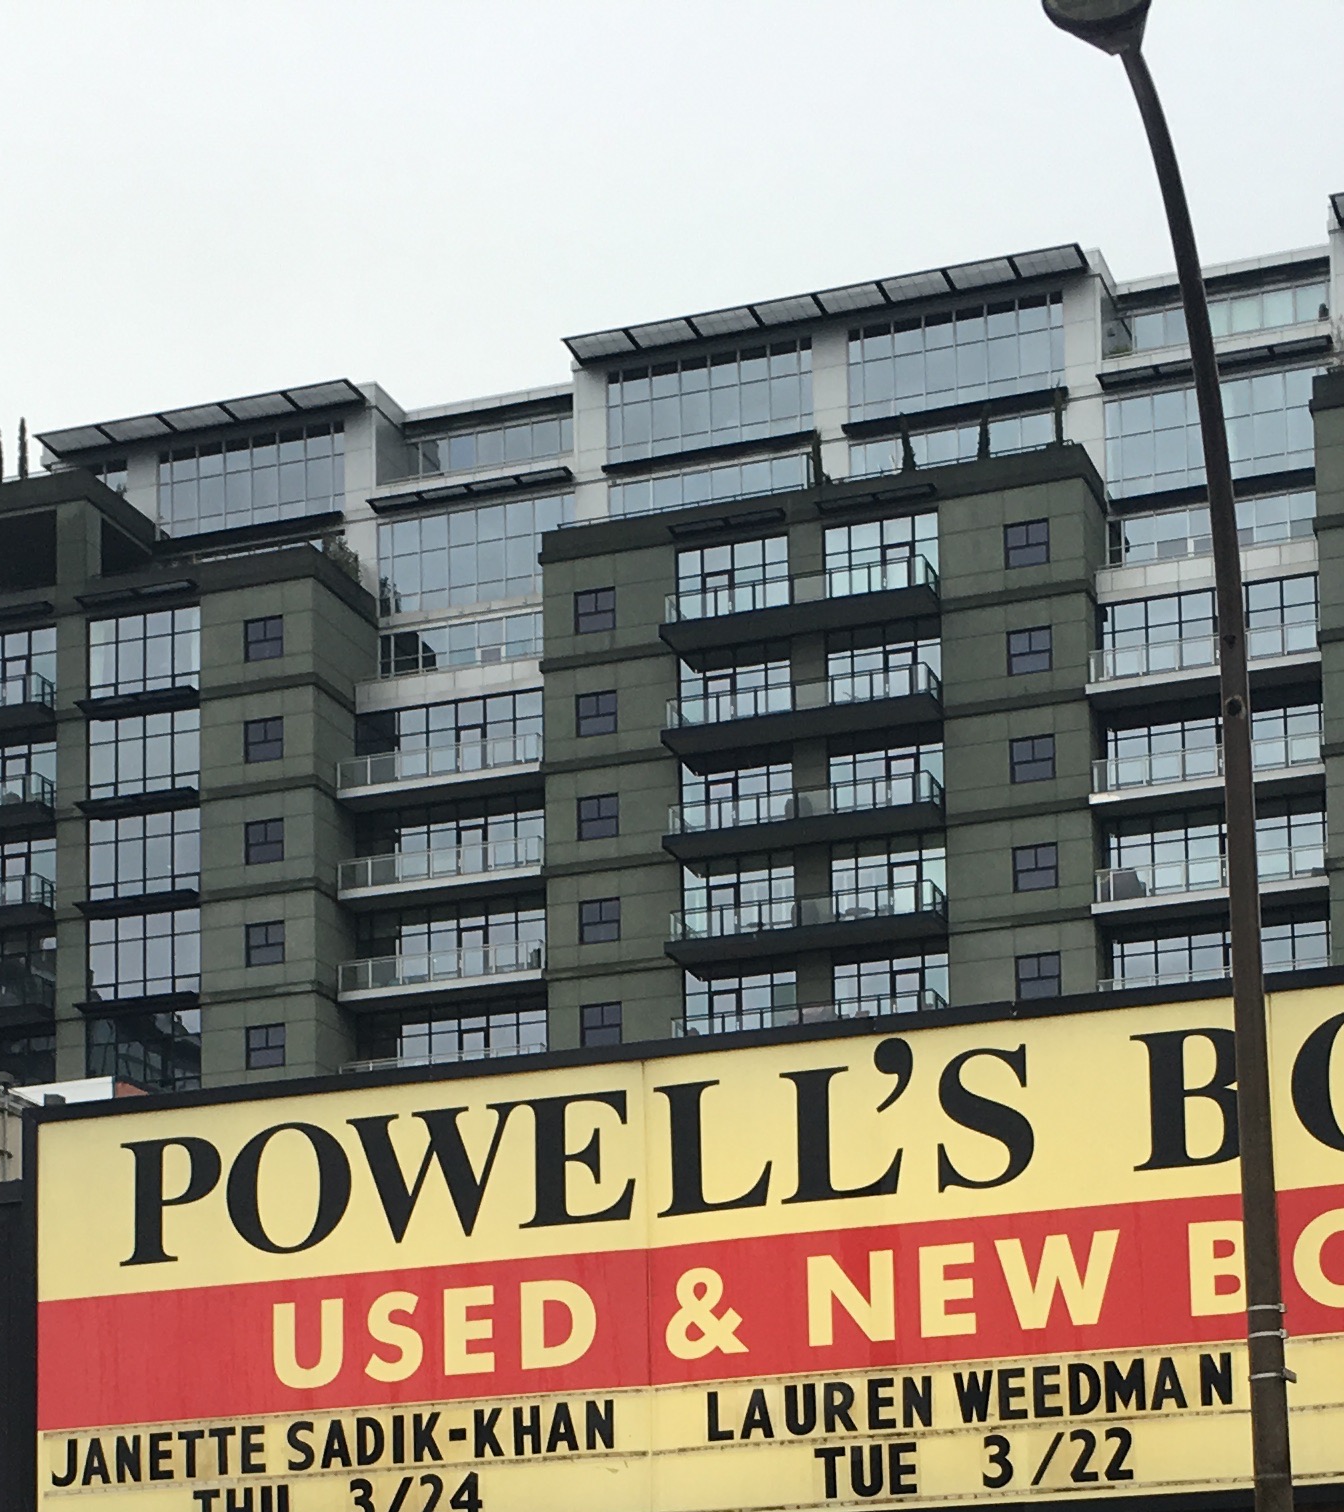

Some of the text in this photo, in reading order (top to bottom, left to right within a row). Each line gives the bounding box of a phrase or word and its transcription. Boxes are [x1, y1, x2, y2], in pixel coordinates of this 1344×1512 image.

[119, 1037, 1036, 1267] POWELL'S
[272, 1278, 597, 1389] USED
[664, 1266, 749, 1360] &
[806, 1229, 1120, 1347] NEW
[707, 1351, 1233, 1442] LAUREN WEEDMAN
[51, 1398, 616, 1488] JANETTE SADIK-KHAN
[813, 1426, 1135, 1500] TUE 3/22
